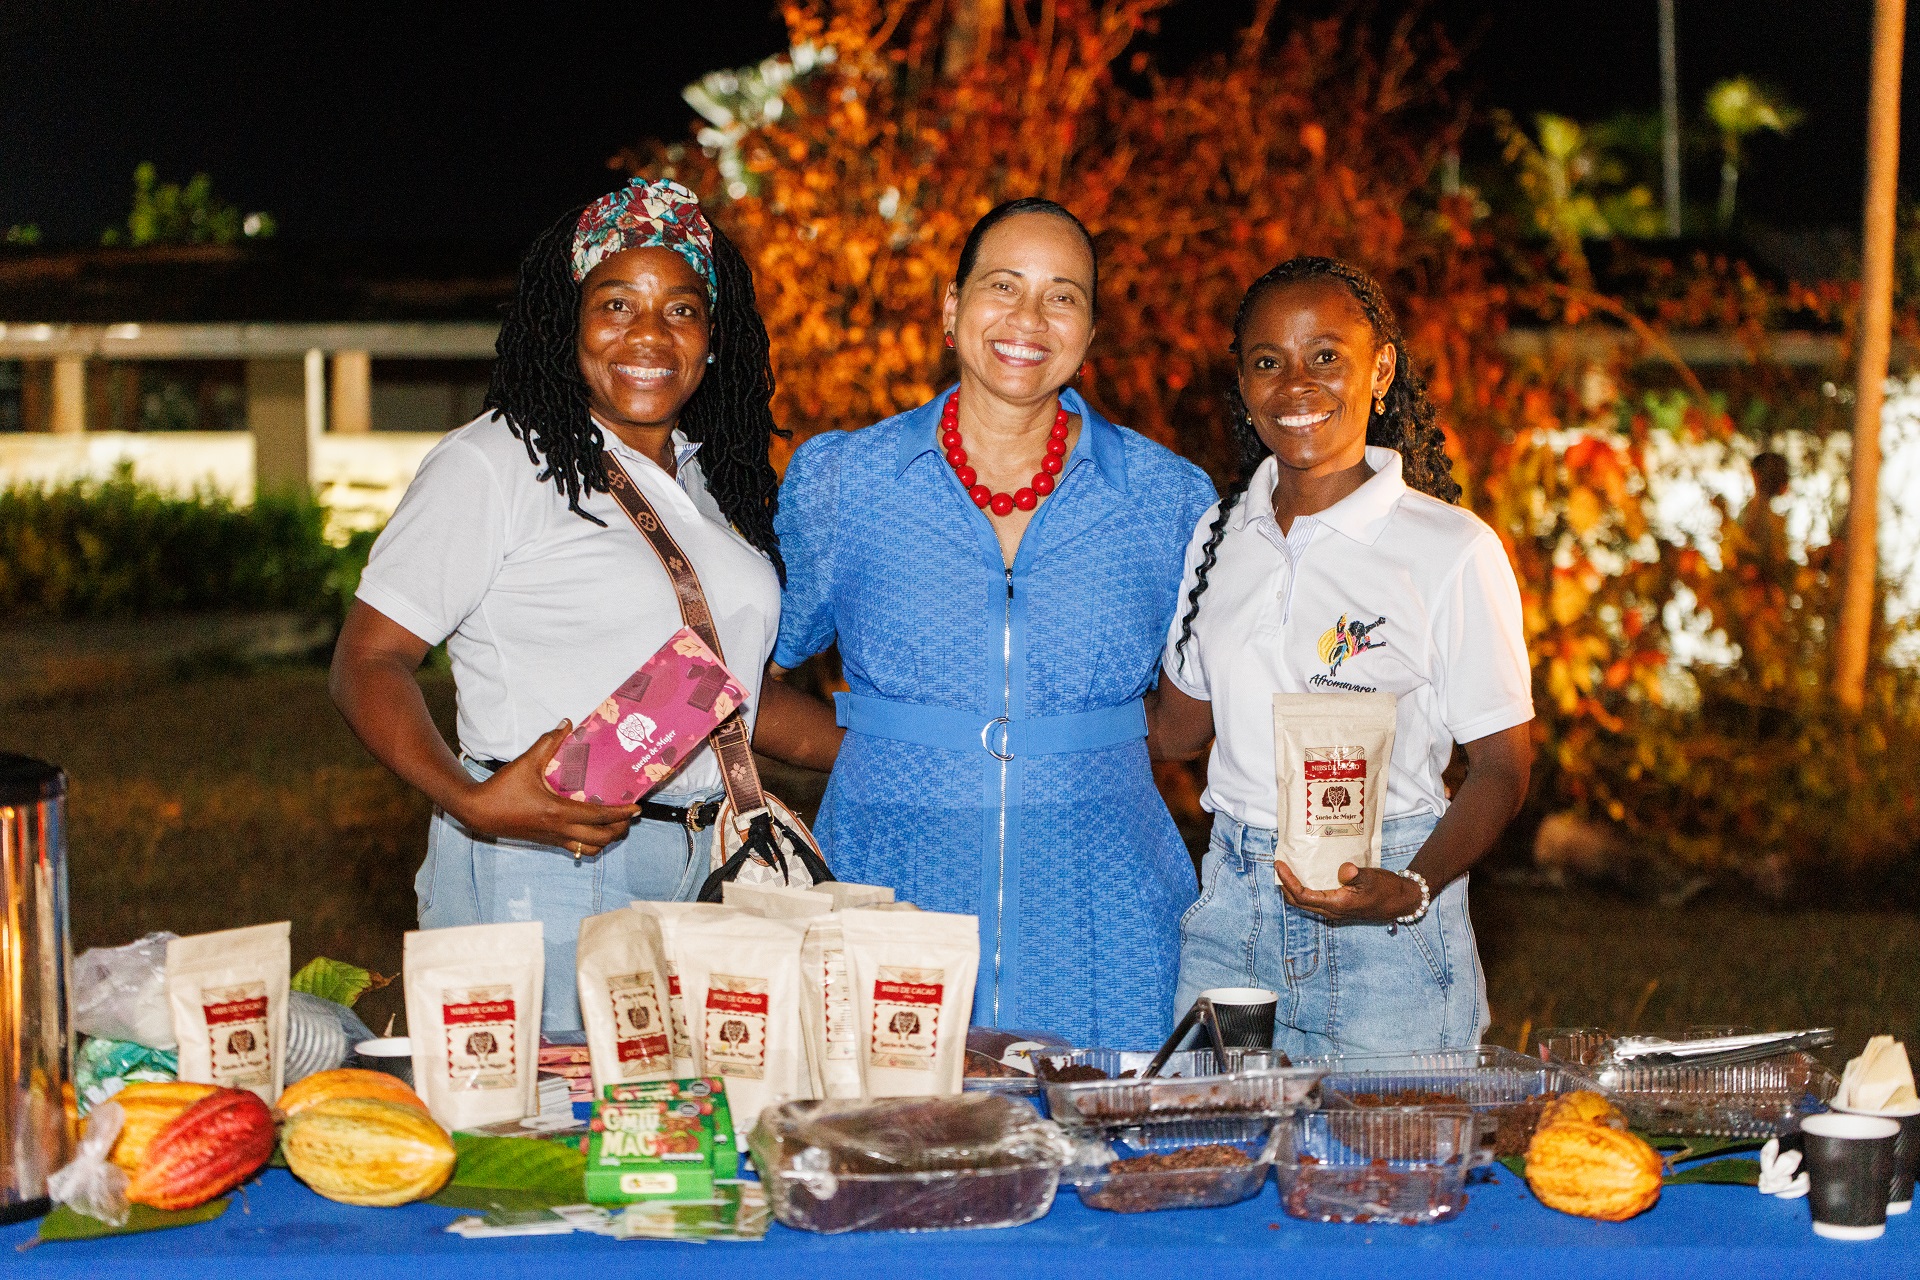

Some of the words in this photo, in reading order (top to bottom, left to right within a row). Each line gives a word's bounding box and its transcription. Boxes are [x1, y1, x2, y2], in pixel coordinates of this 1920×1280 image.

[649, 746, 659, 756] de
[656, 730, 677, 750] Mujer
[1340, 813, 1357, 821] Mujer
[900, 986, 911, 994] DE
[911, 986, 937, 996] CACAO
[736, 995, 762, 1005] CACAO
[480, 1004, 509, 1014] CACAO
[600, 1130, 657, 1157] MAC
